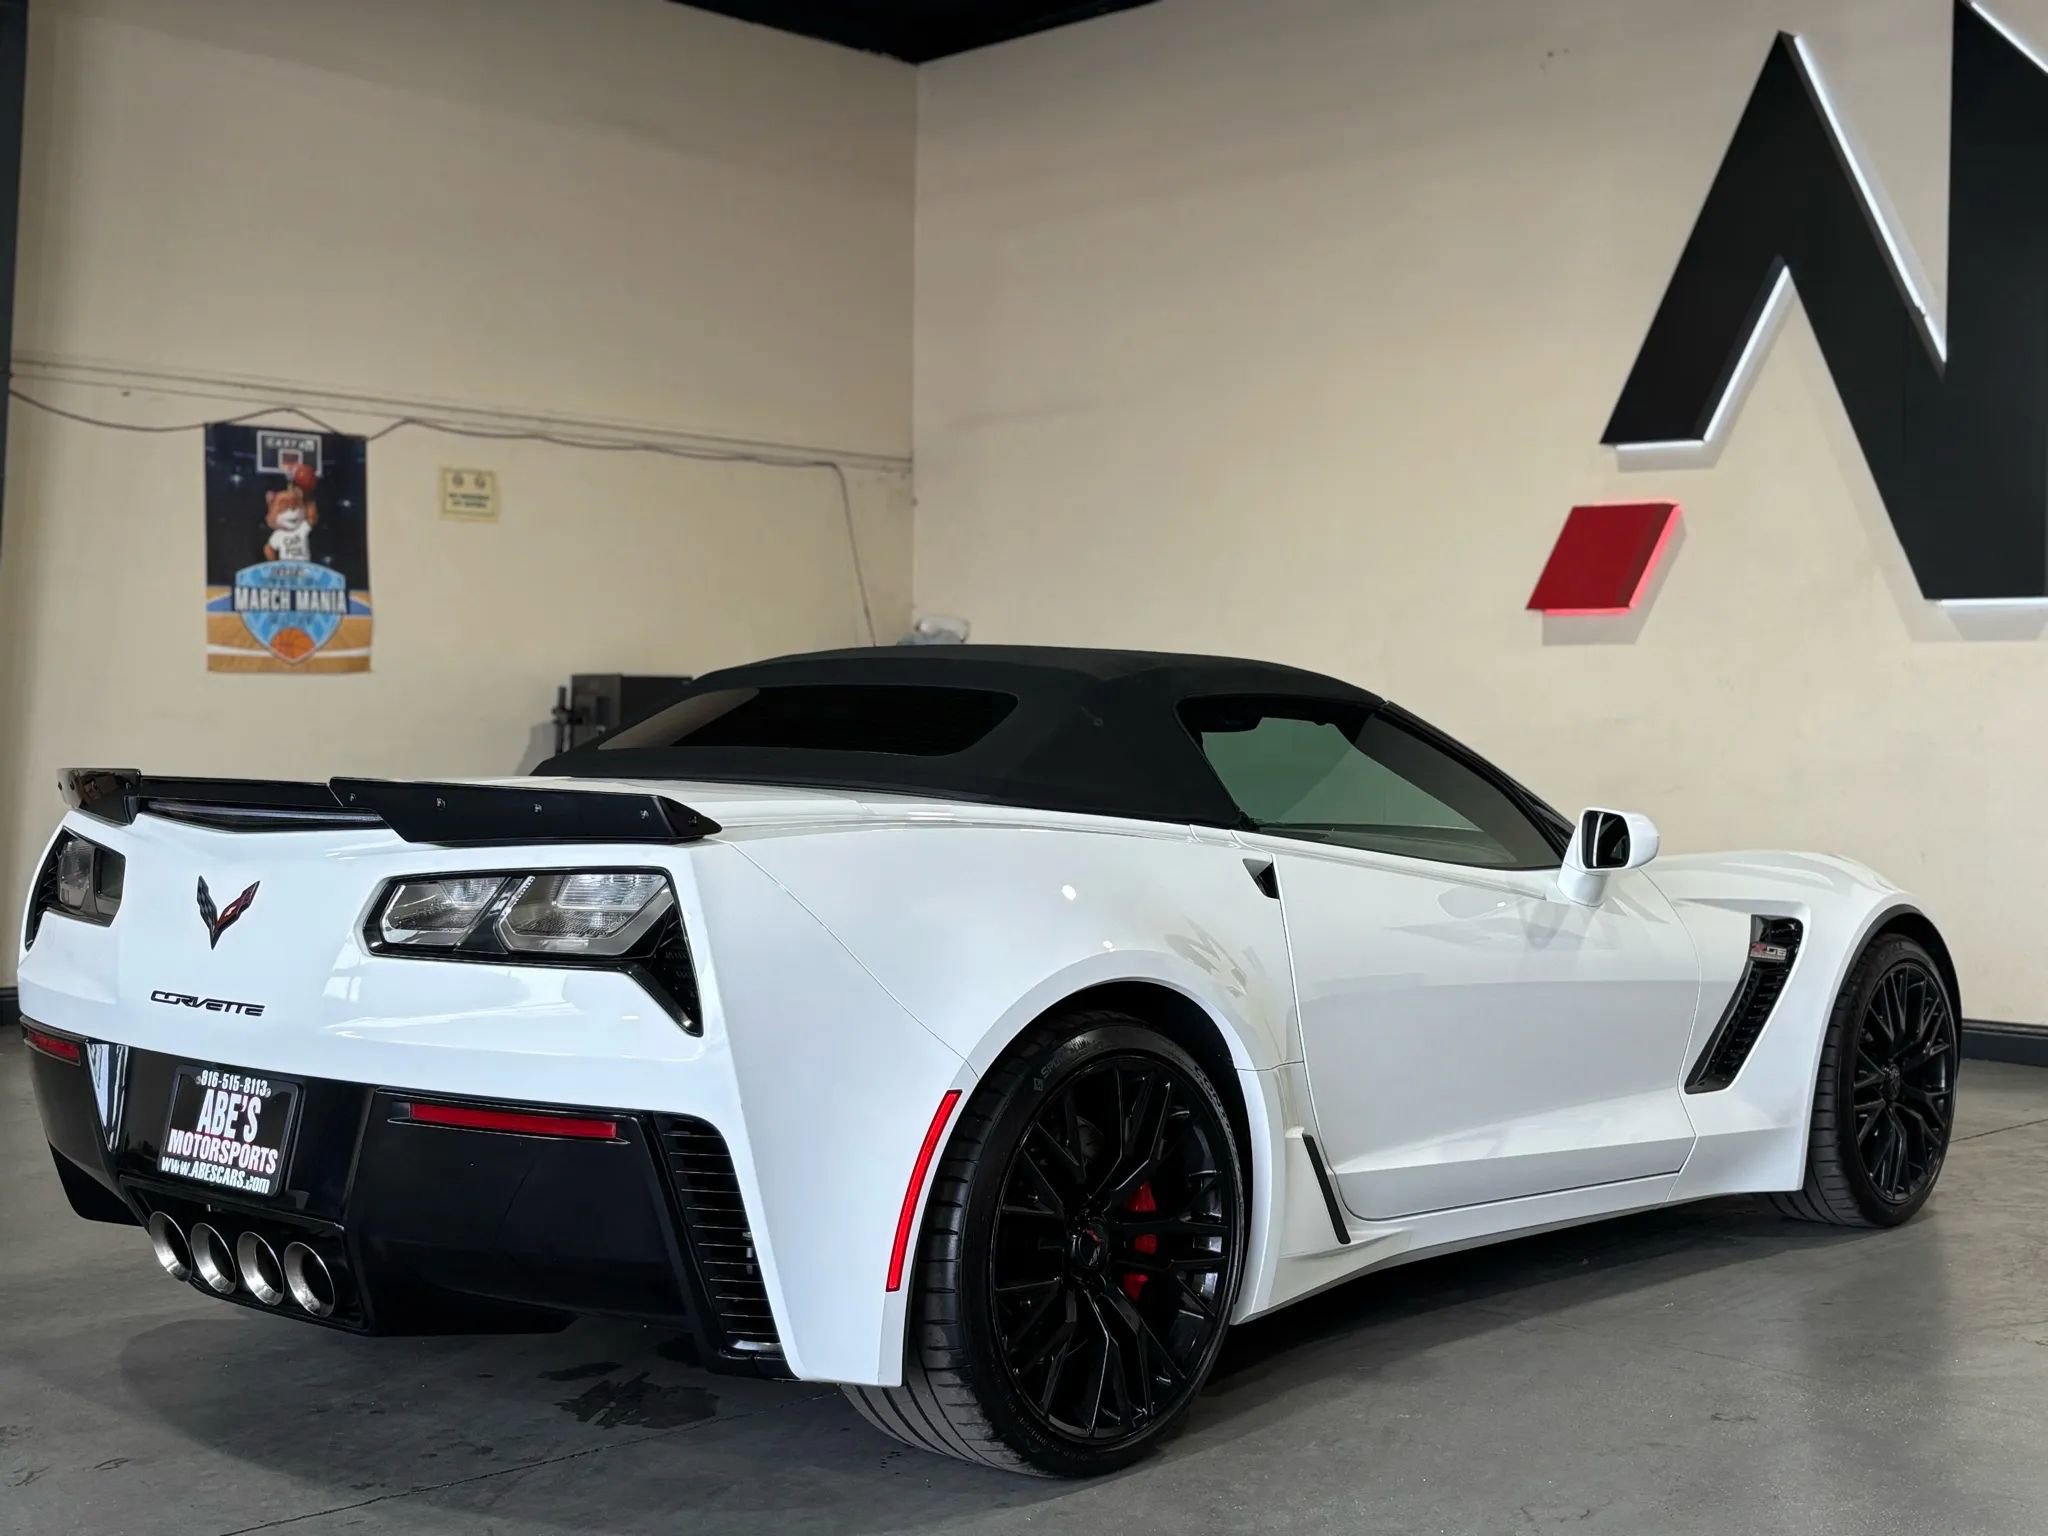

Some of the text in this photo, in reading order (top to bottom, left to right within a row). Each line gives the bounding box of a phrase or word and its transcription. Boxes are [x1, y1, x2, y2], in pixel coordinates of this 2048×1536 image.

[234, 586, 347, 614] MARCH MANIA
[150, 990, 266, 1017] CORVETTE
[196, 1089, 262, 1143] ABE'S
[167, 1128, 279, 1175] MOTORSPORTS
